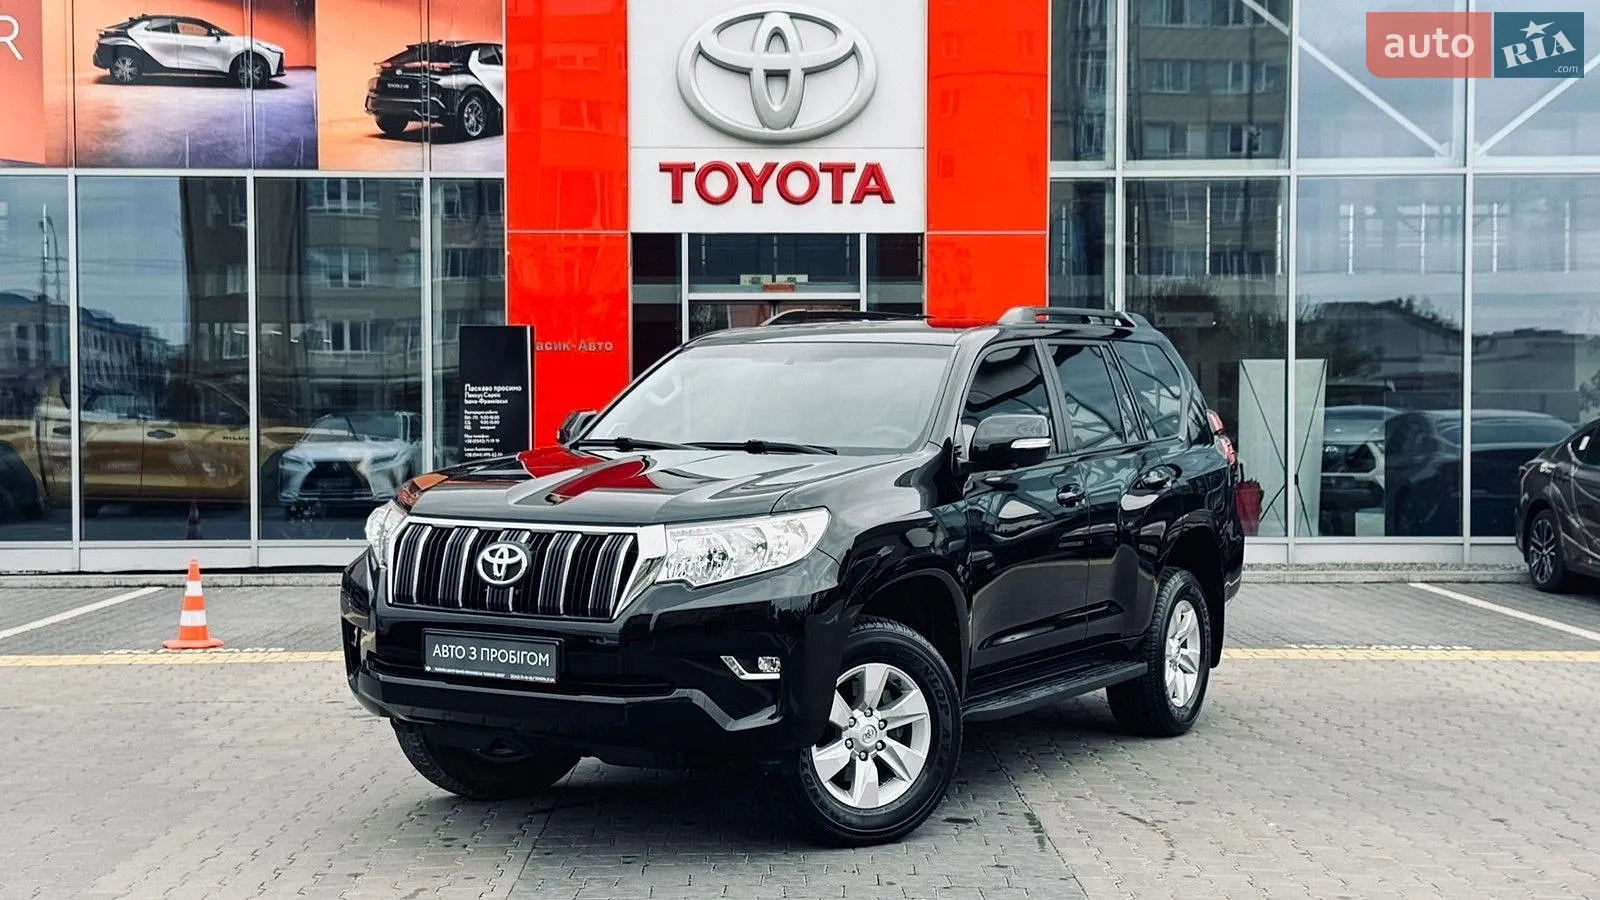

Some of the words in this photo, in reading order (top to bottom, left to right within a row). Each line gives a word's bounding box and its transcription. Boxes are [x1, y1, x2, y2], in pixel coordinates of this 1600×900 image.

[0, 15, 23, 60] R
[659, 161, 895, 205] TOYOTA
[432, 644, 466, 660] АВТО
[469, 646, 477, 661] З
[480, 647, 550, 667] ПРОБІГОМ
